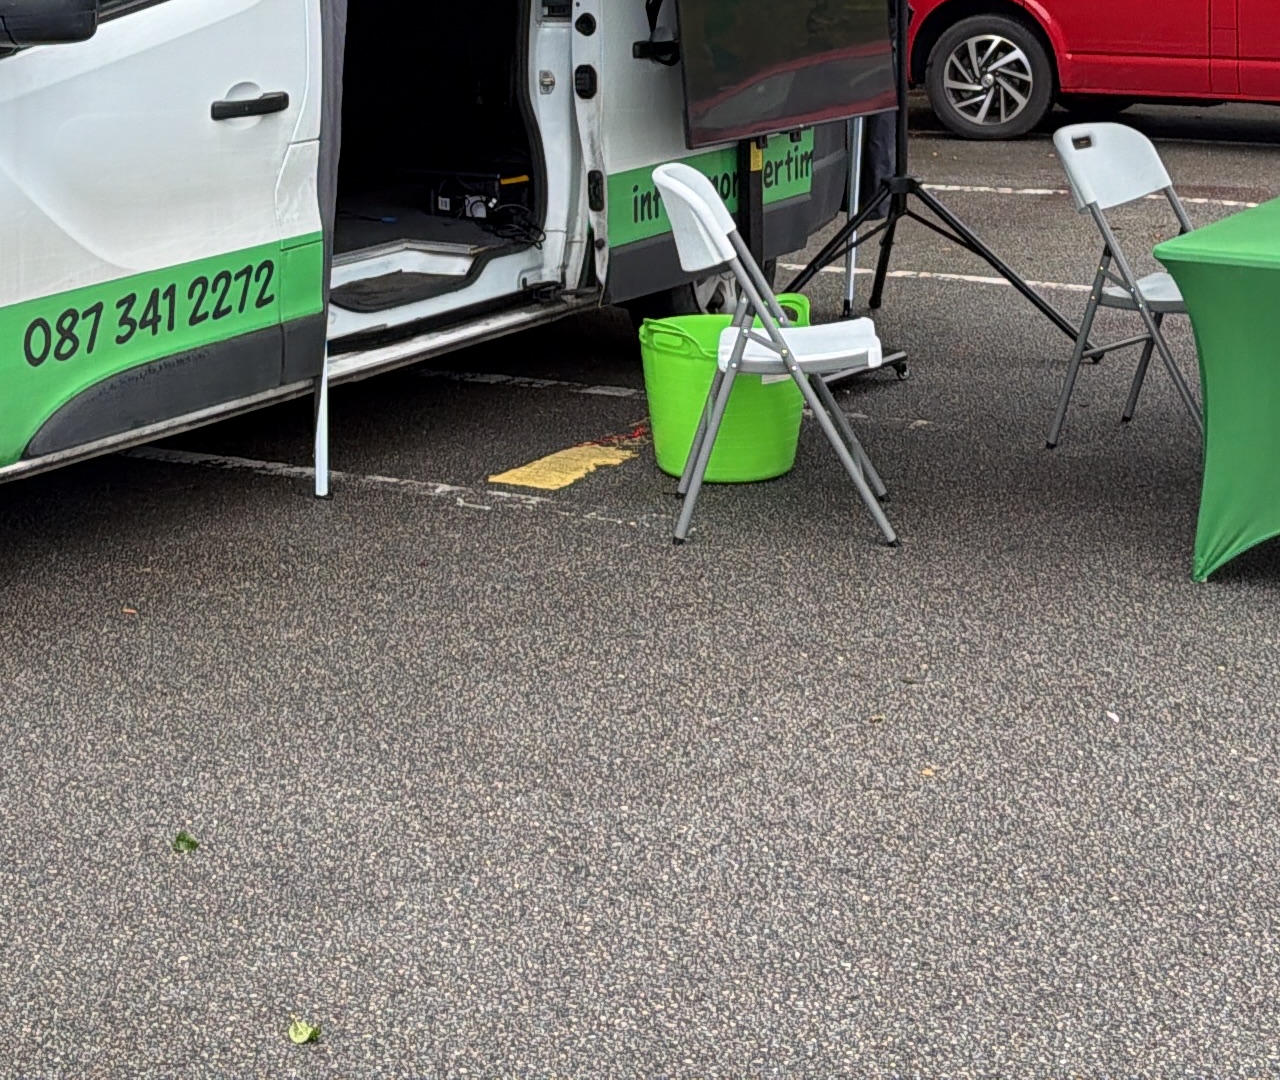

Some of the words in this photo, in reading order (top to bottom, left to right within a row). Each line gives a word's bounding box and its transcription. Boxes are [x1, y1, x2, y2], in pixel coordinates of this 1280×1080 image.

[23, 300, 105, 368] 087
[114, 282, 177, 346] 341
[186, 259, 275, 327] 2272
